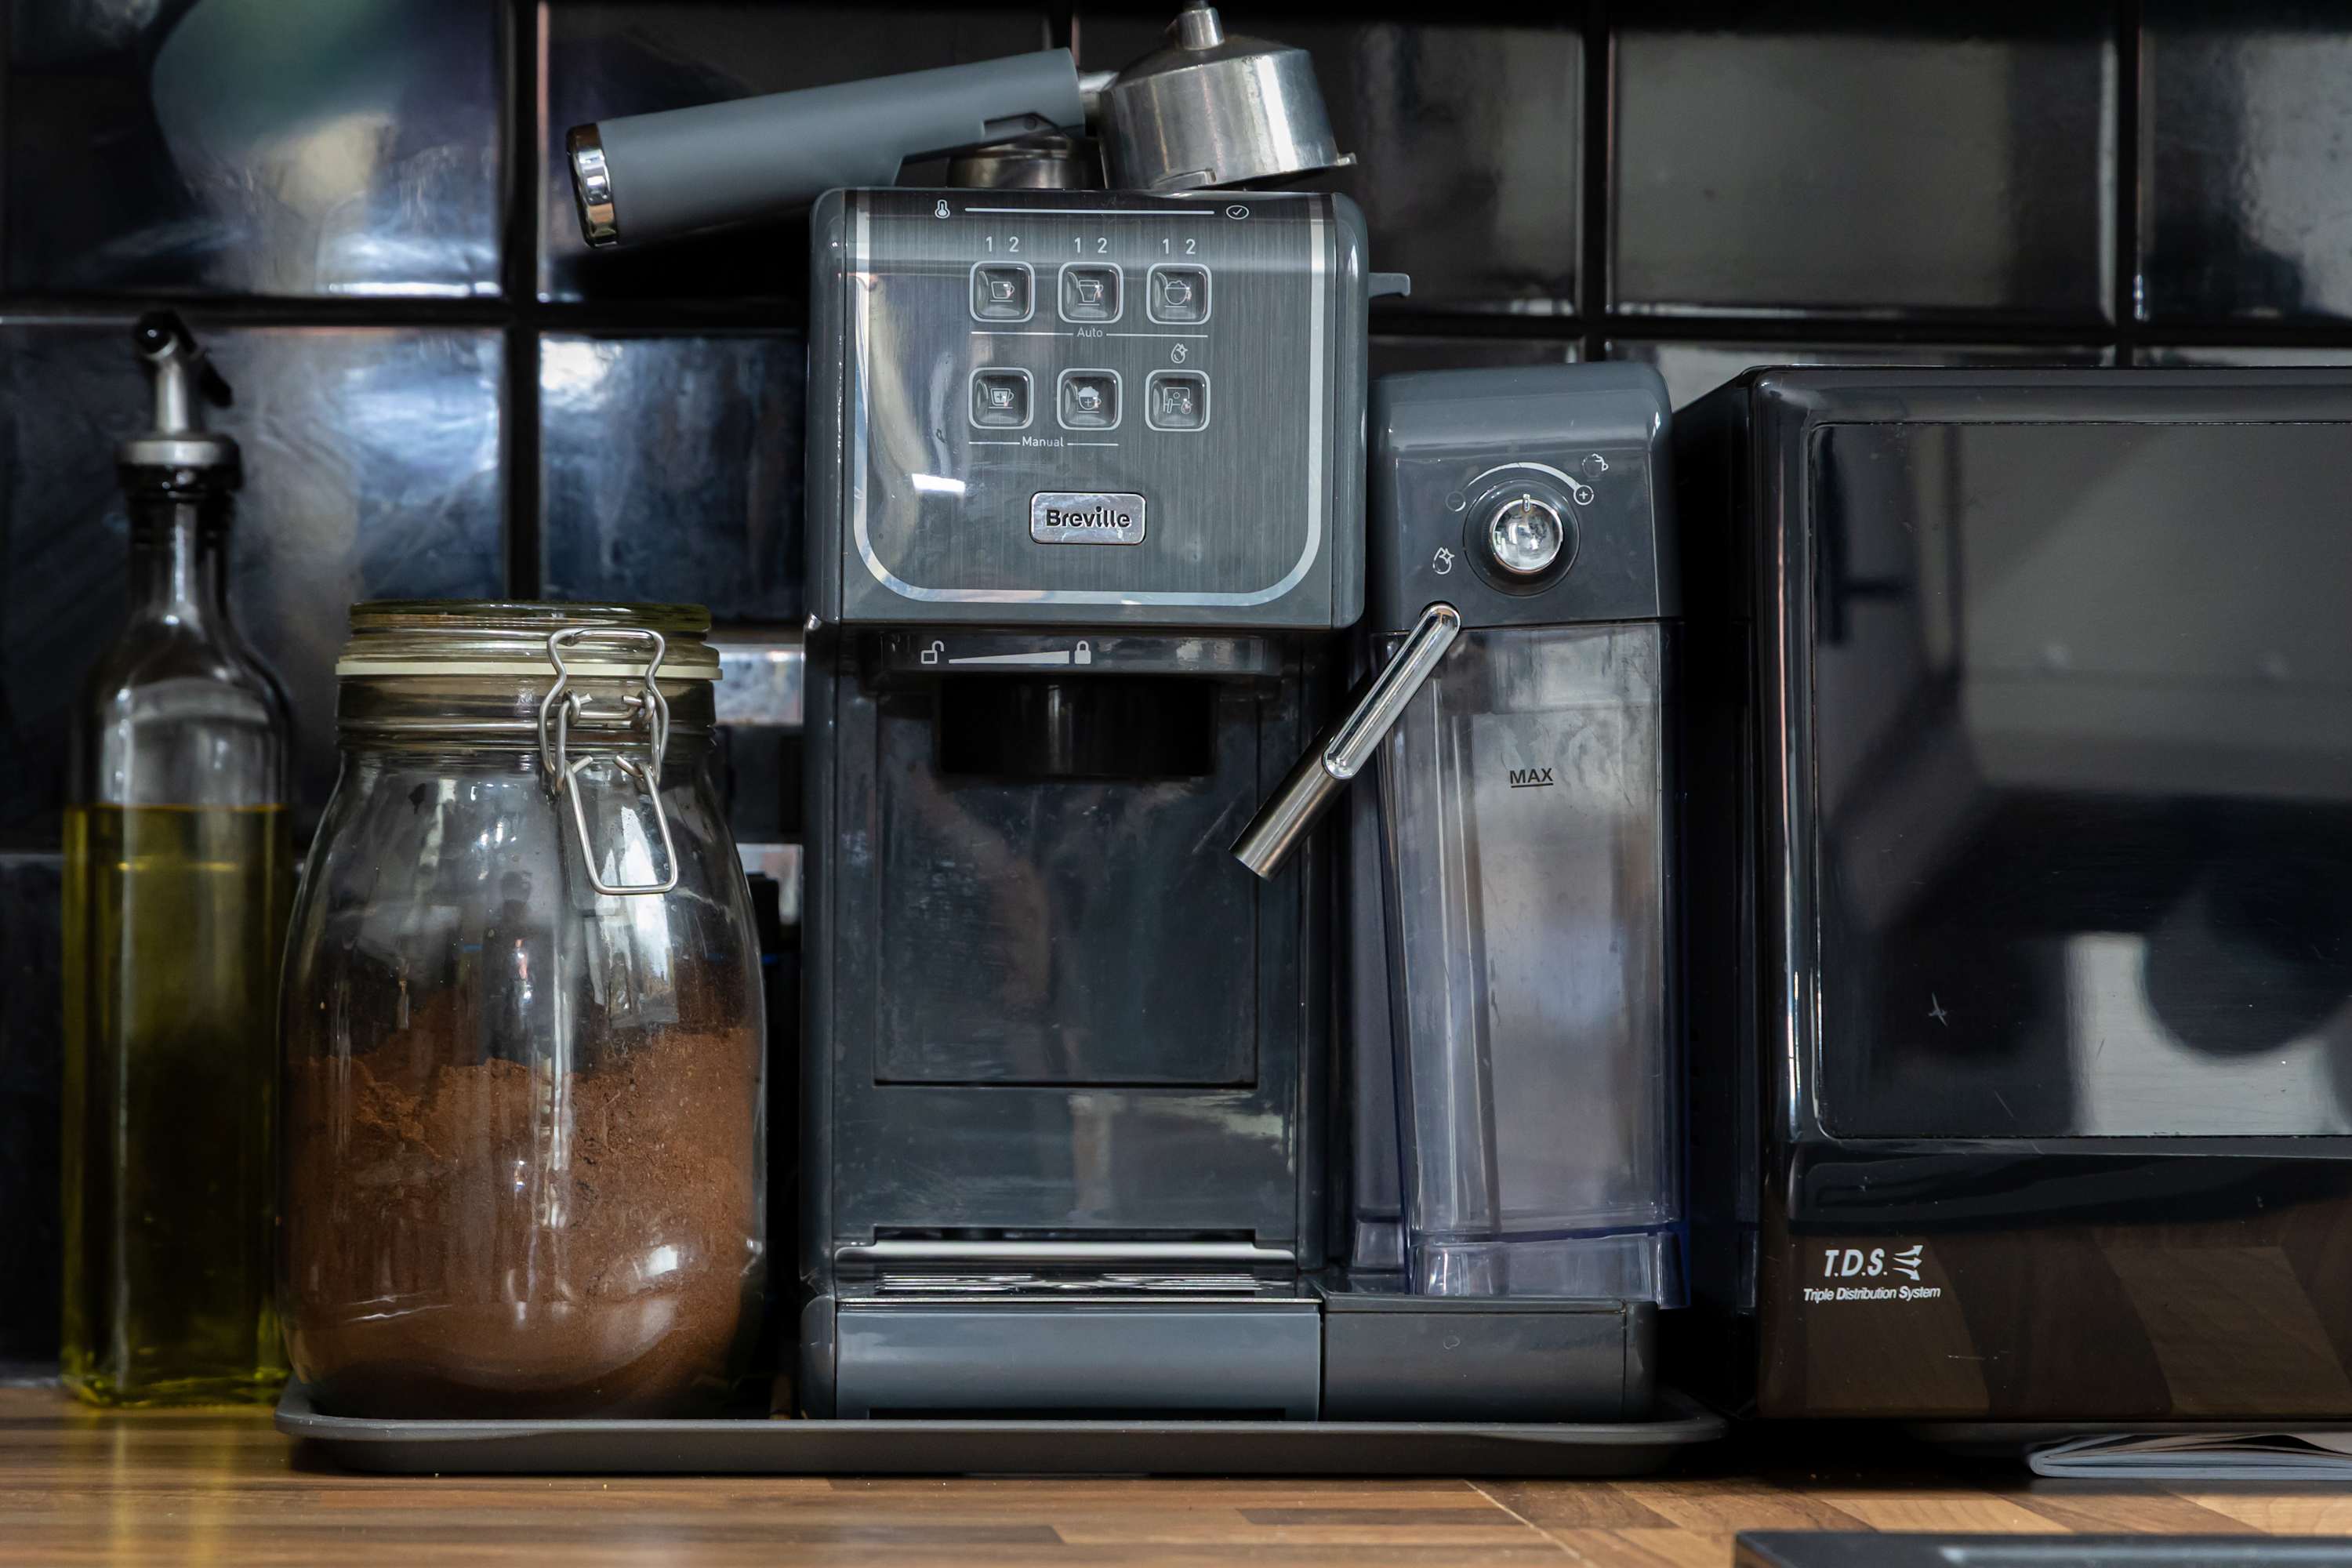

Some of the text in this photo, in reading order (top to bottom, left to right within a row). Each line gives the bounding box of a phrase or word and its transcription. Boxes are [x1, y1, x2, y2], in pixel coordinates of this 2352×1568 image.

[985, 236, 1020, 252] 1 2
[1074, 237, 1109, 253] 1 2
[1162, 238, 1196, 255] 1 2
[1076, 327, 1104, 339] Auto
[1022, 436, 1064, 448] Manual
[1046, 506, 1131, 528] Breville
[1509, 768, 1554, 784] MAX
[1824, 1247, 1889, 1278] T.D.S.
[1802, 1285, 1942, 1304] Triple Distribution System
